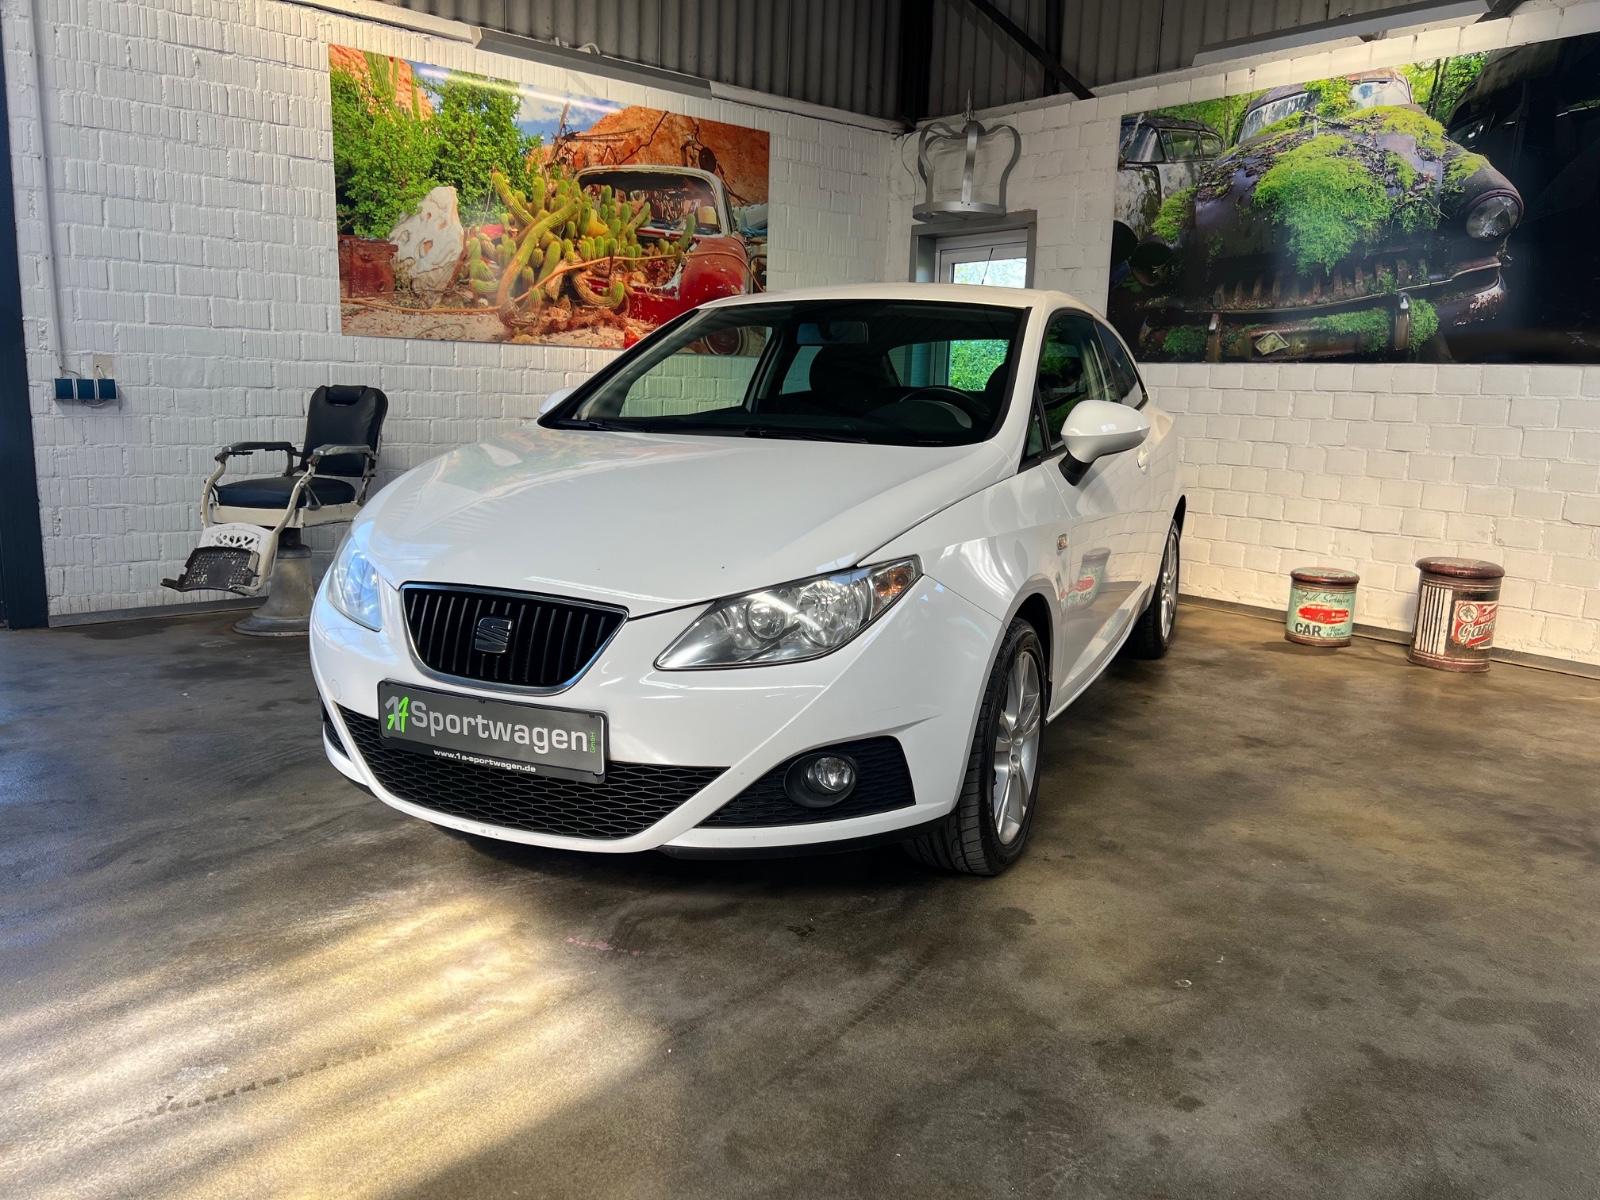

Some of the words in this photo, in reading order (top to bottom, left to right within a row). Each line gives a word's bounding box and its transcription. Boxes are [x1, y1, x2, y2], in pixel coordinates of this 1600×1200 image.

[1295, 622, 1322, 637] CAR
[411, 700, 589, 755] Sportwagen
[433, 748, 537, 774] www.1a-sportwagen.de
